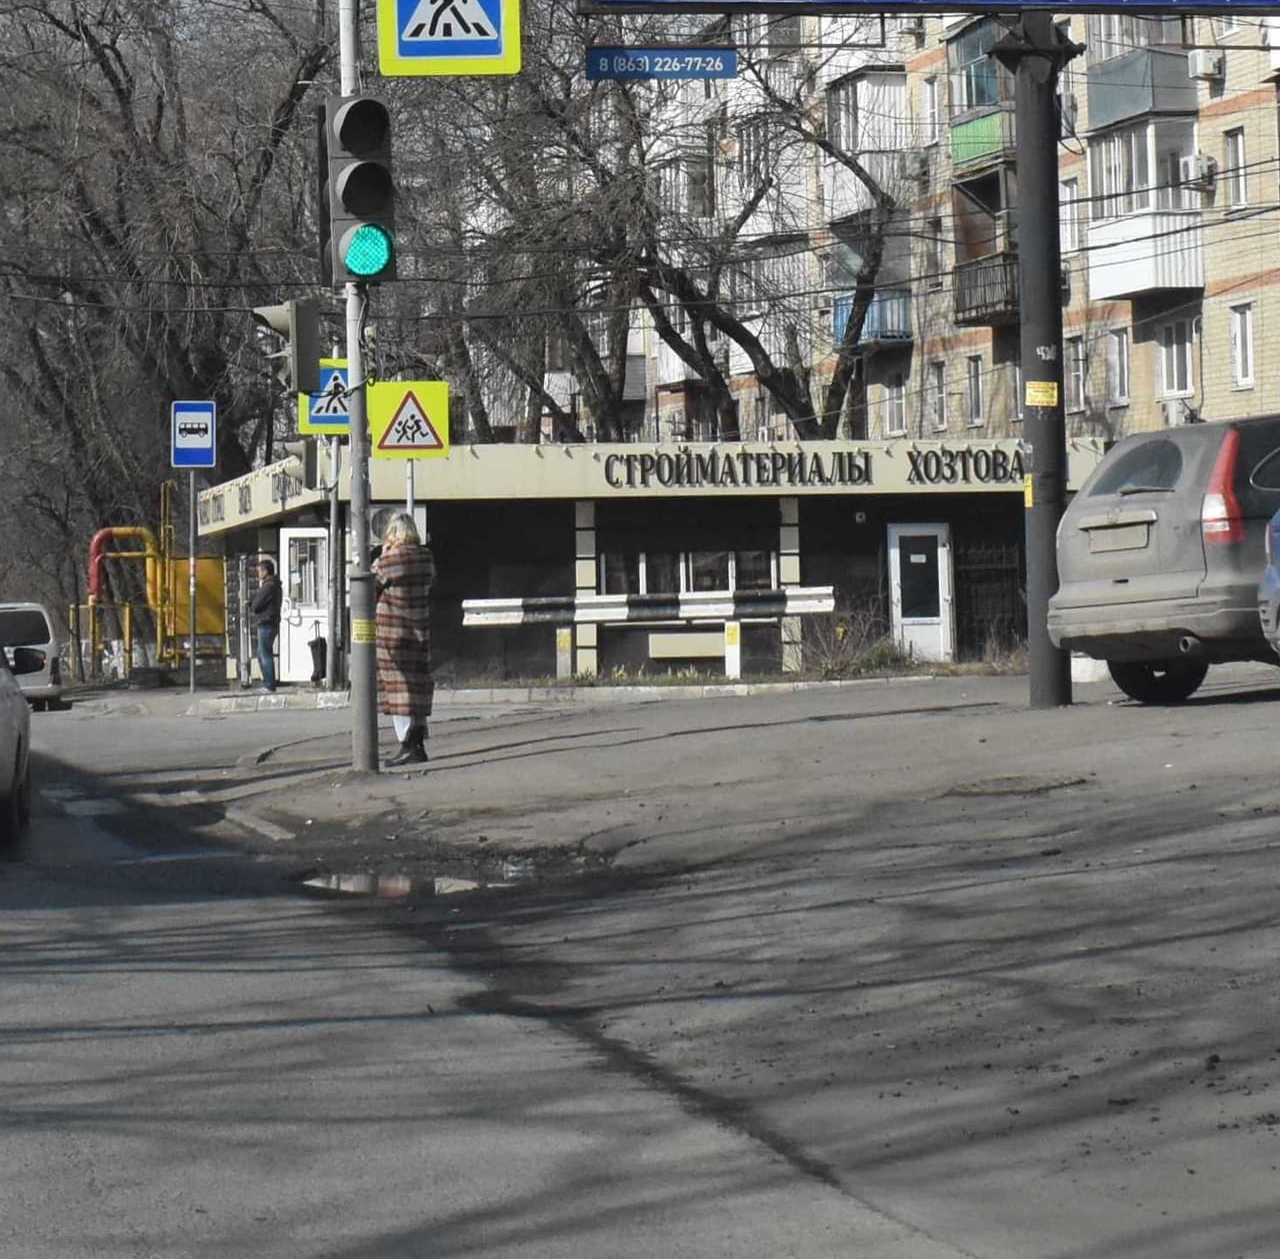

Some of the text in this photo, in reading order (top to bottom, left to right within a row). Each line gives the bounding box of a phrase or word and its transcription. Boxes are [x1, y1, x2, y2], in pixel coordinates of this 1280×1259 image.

[599, 55, 724, 73] 8 (863) 226-77-26
[604, 446, 1024, 489] СТРОЙМАТЕРИАЛЫ ХОЗТОВА
